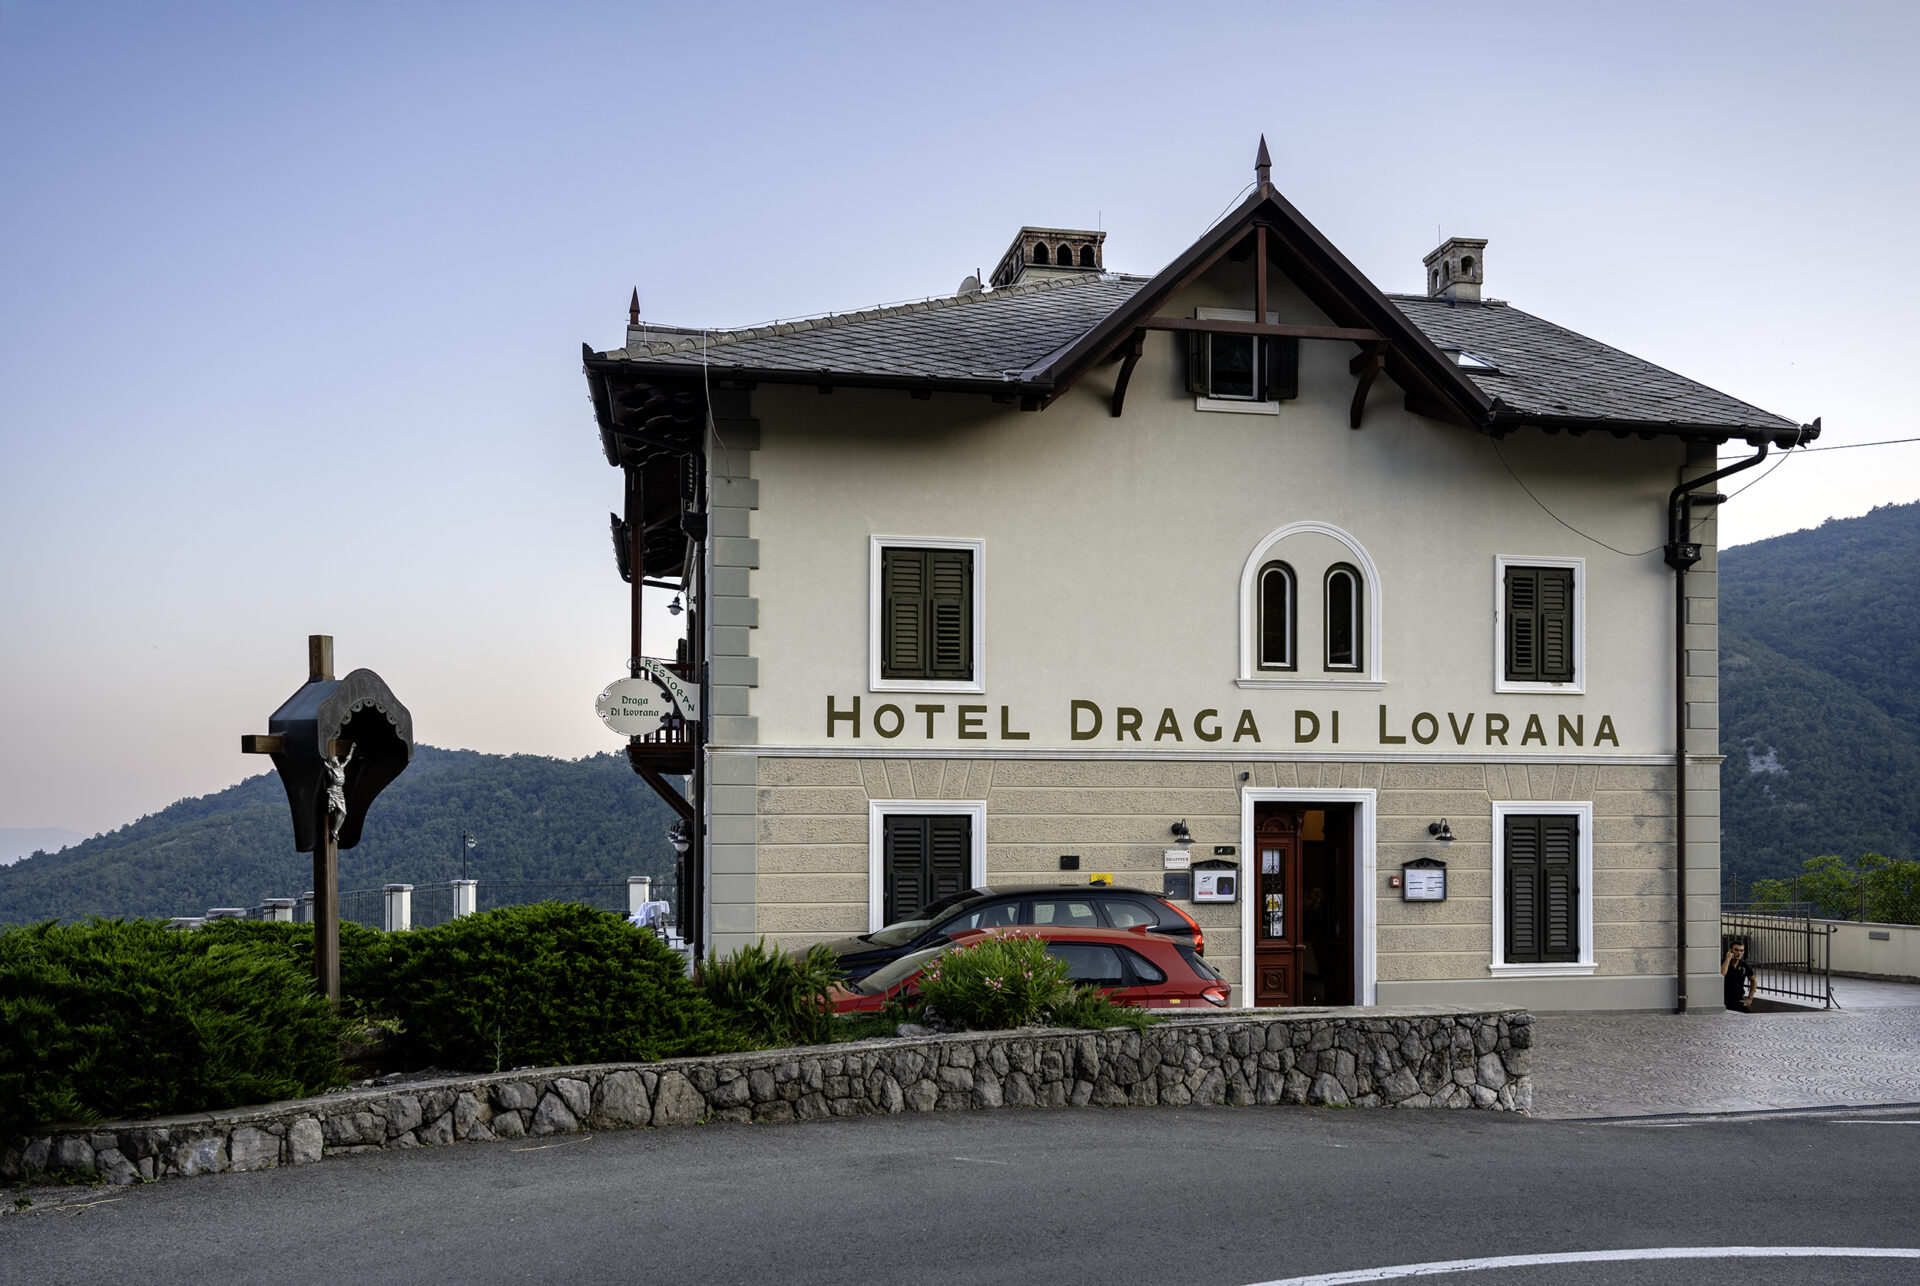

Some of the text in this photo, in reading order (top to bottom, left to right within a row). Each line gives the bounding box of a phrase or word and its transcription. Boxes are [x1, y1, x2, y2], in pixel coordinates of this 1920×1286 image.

[621, 696, 649, 706] Draga
[645, 659, 695, 712] RESTORAN
[610, 707, 659, 717] Di Lovrana
[826, 695, 1620, 747] HOTEL DRAGA DI LOVRANA
